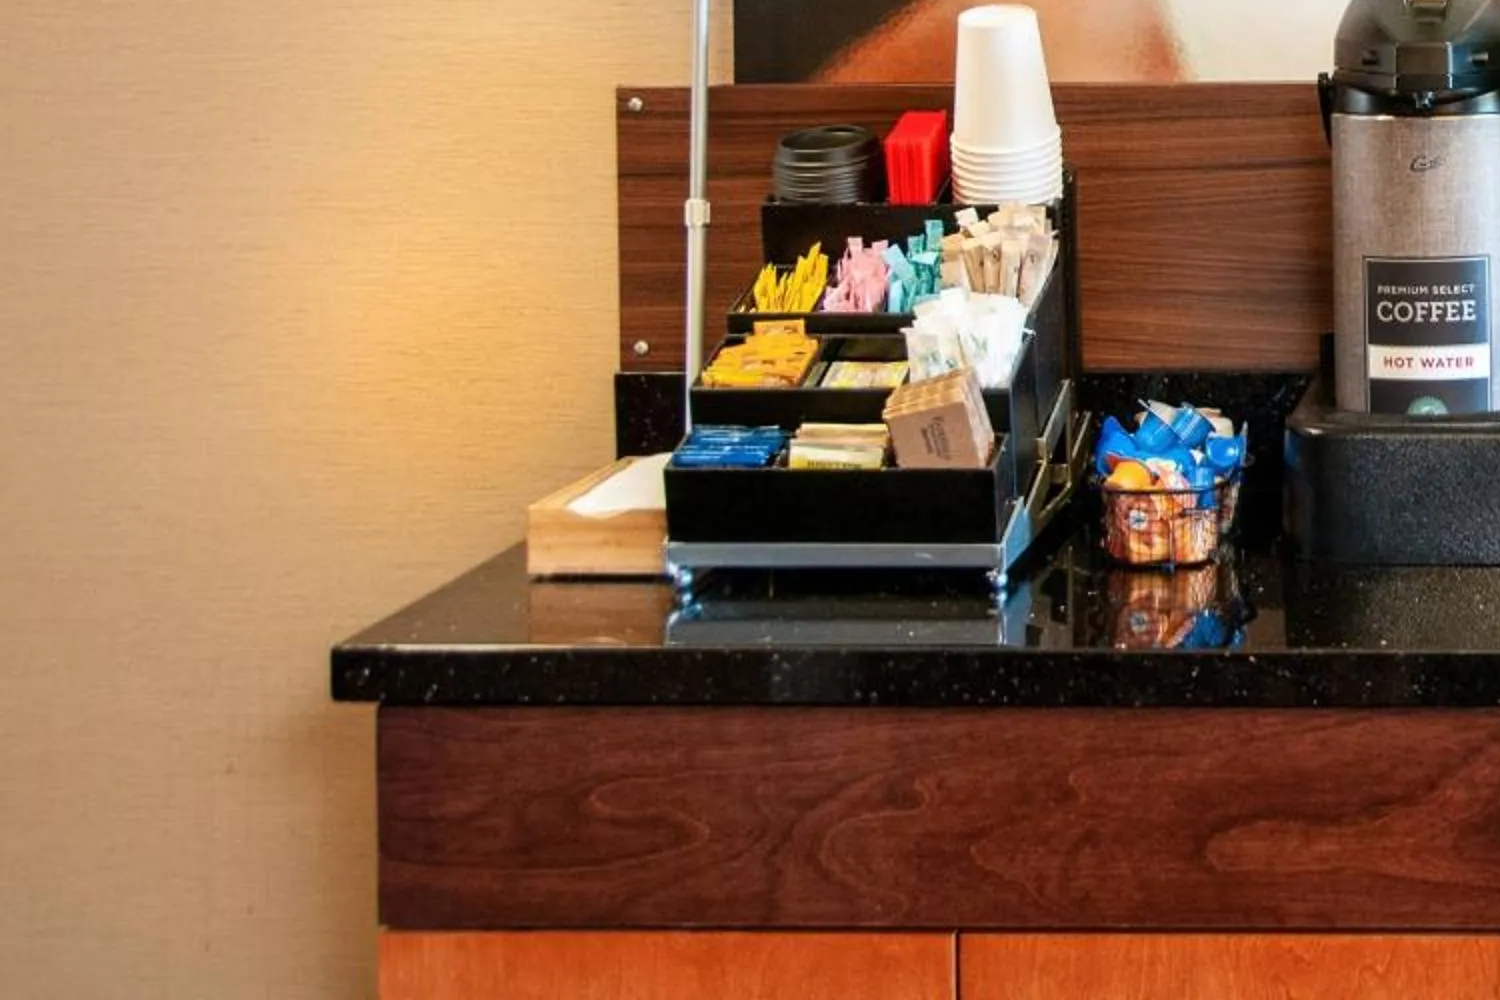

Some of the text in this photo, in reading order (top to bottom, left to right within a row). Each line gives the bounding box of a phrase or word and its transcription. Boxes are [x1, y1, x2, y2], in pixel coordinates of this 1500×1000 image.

[1376, 283, 1476, 296] PREMIUM SELECT
[1376, 300, 1477, 323] COFFEE
[1383, 356, 1475, 369] HOT WATER
